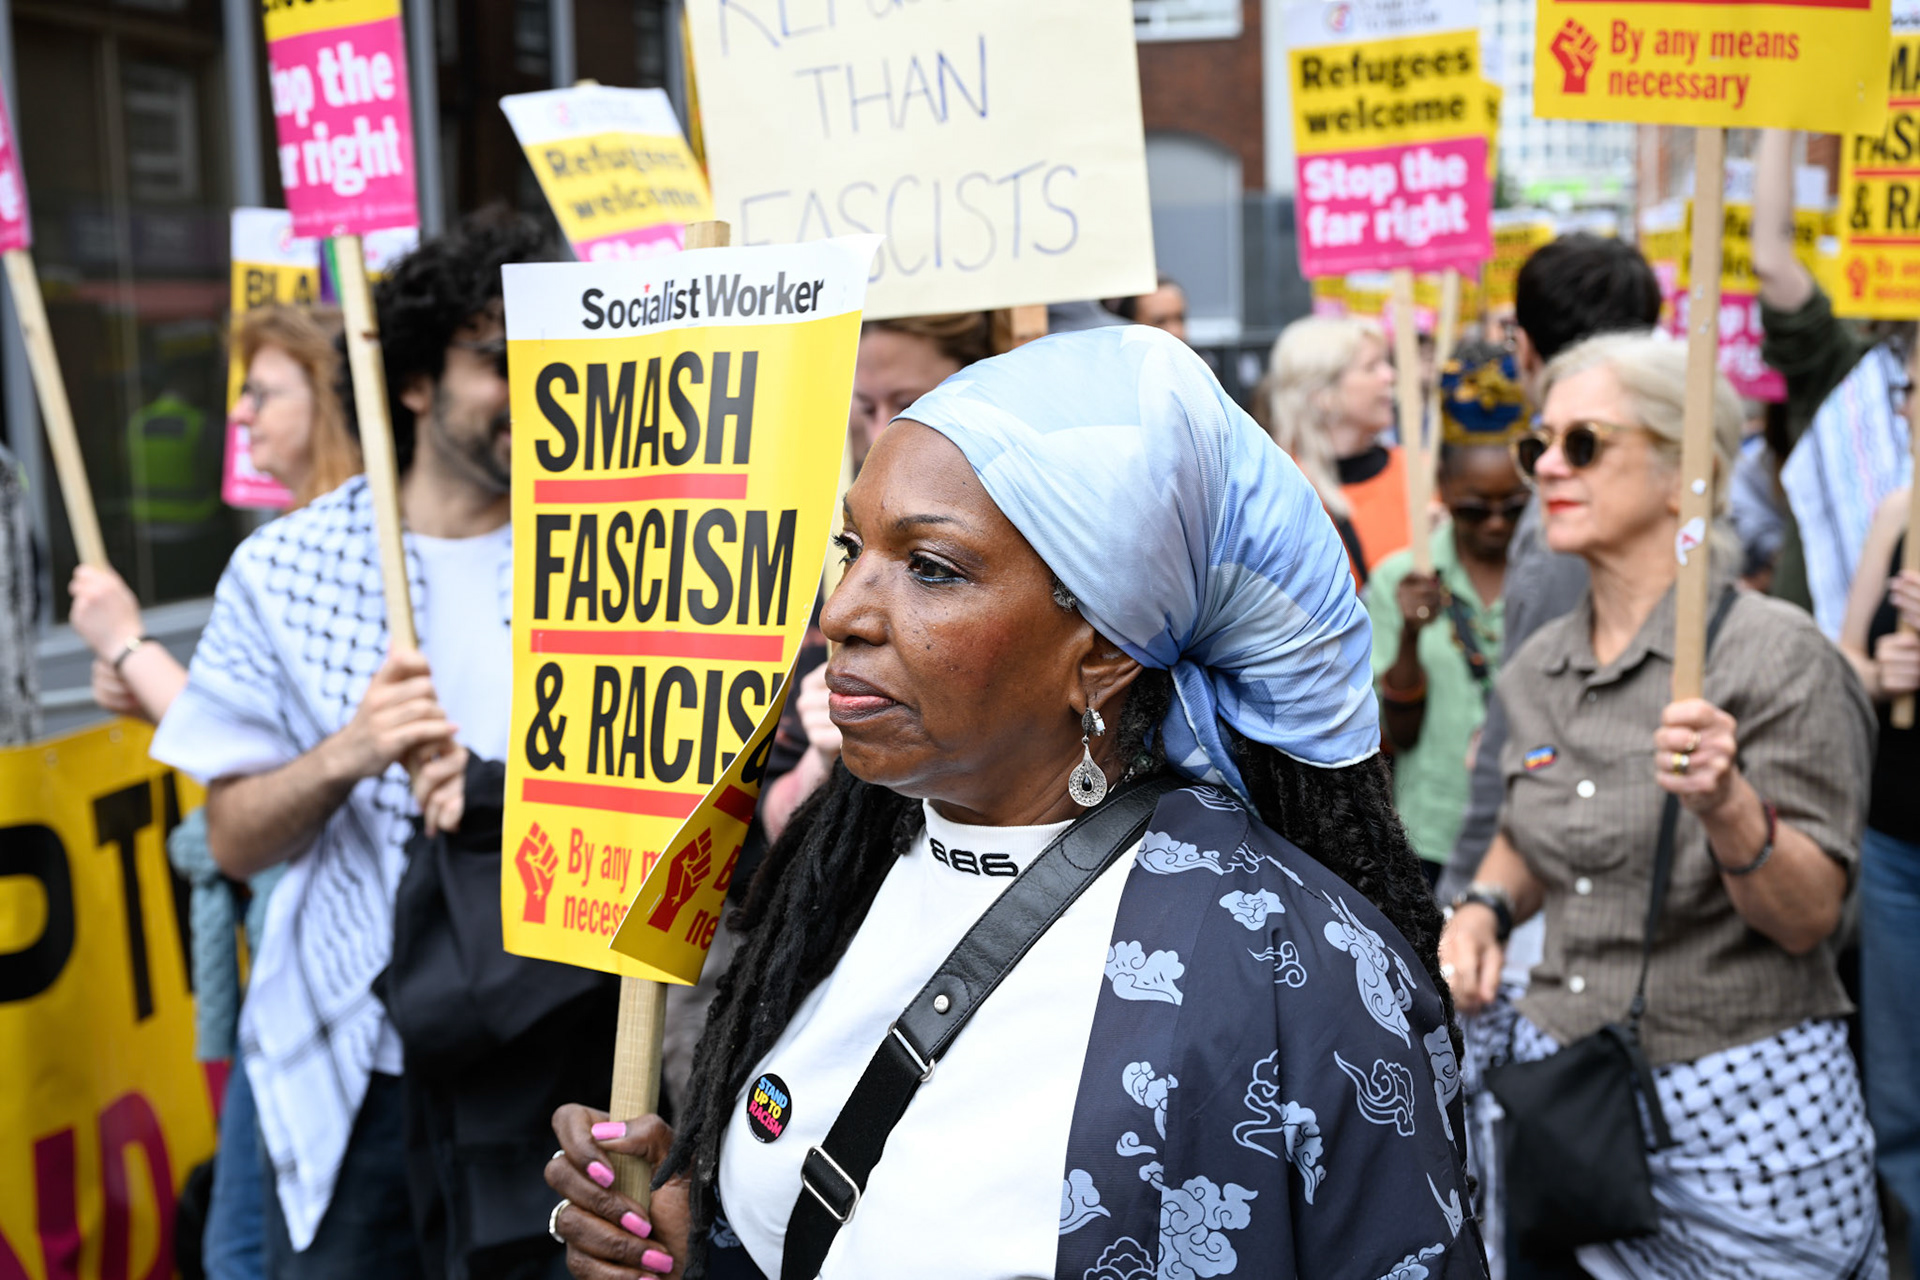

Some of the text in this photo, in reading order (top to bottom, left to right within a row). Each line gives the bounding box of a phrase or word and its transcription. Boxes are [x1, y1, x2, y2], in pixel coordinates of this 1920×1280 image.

[1301, 50, 1472, 91] Refugees
[1611, 19, 1799, 66] By any means
[269, 40, 395, 128] op the
[794, 34, 987, 139] THAN
[1608, 70, 1750, 110] necessary
[1305, 95, 1466, 134] welcome
[302, 116, 402, 197] right
[1303, 147, 1468, 206] Stop the
[740, 160, 1078, 284] FASCISTS
[1307, 192, 1469, 248] far right
[581, 271, 825, 331] Socialist Worker
[535, 351, 759, 472] SMASH
[533, 508, 798, 626] FASCISM
[525, 661, 567, 771] &
[587, 665, 785, 785] RACIS
[568, 827, 595, 887] By
[600, 844, 632, 894] any
[748, 1100, 782, 1137] RACISM
[754, 1088, 782, 1119] UP TO
[758, 1076, 788, 1109] STAND
